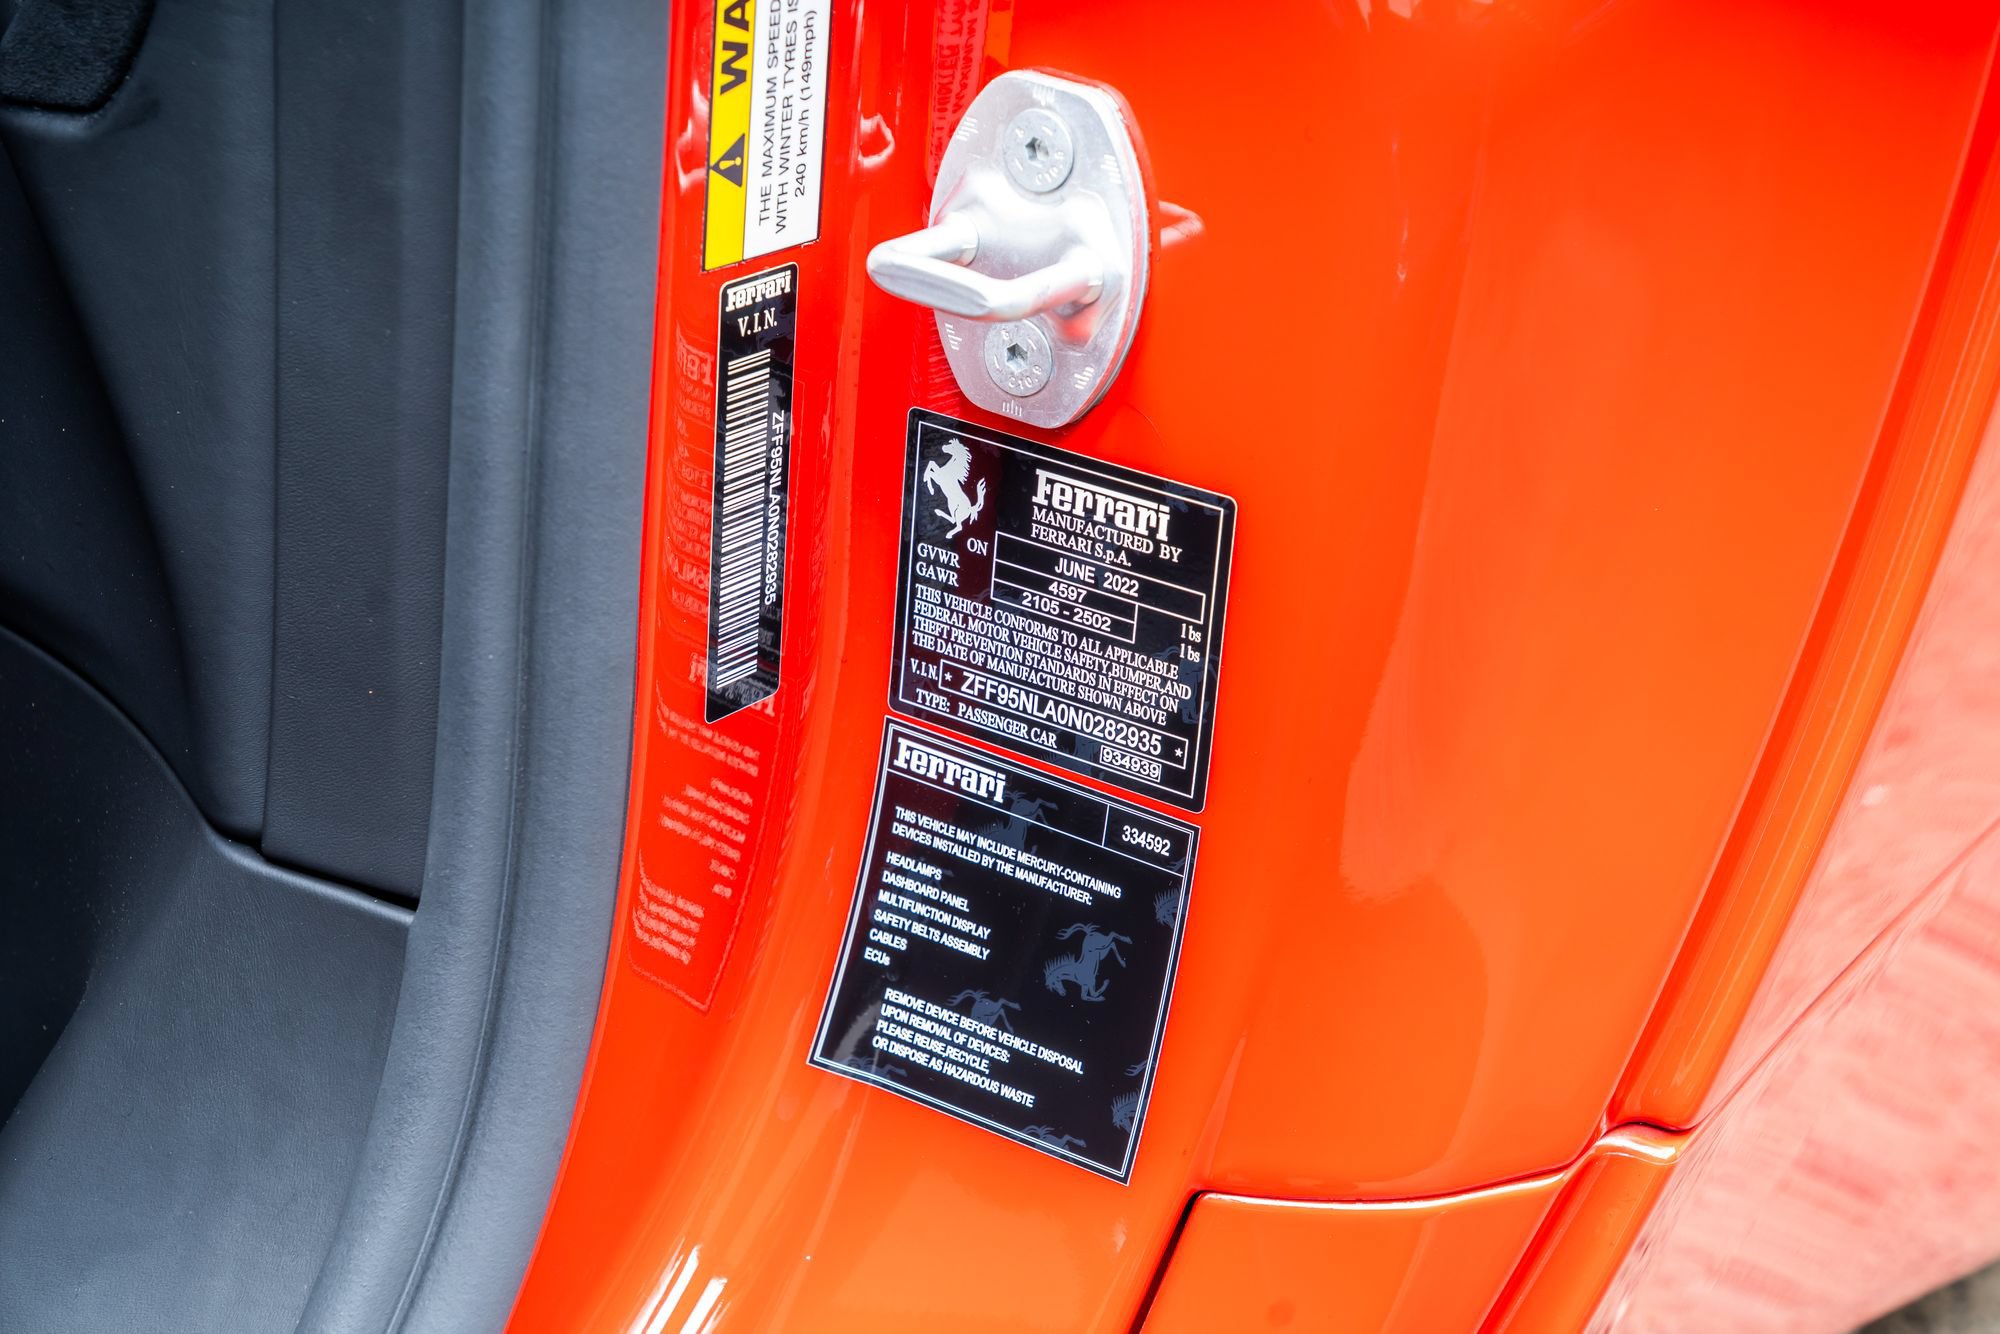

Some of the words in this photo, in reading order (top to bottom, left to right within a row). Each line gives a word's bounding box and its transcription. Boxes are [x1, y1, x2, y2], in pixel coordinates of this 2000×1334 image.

[767, 0, 781, 69] SPEED
[783, 20, 798, 91] TYRES
[800, 10, 818, 102] (149mph)
[762, 75, 778, 179] MAXIMUM
[778, 94, 793, 177] WINTER
[797, 108, 810, 162] km/h
[759, 183, 772, 226] THE
[794, 163, 807, 197] 240
[775, 181, 788, 234] WITH
[725, 270, 792, 312] Ferrari
[737, 307, 778, 337] V.I.N.
[764, 409, 785, 606] ZFF95NLA0N0282935
[1031, 468, 1171, 542] Ferrari
[917, 542, 961, 569] GVWR
[966, 537, 989, 556] ON
[1030, 522, 1093, 555] FERRARI
[1094, 542, 1132, 567] S.p.A.
[1032, 505, 1154, 554] MANUFACTURED
[1158, 543, 1183, 563] BY
[915, 561, 959, 588] GAWR
[1048, 581, 1088, 603] 4597
[1054, 557, 1096, 584] JUNE
[1102, 571, 1140, 598] 2022
[913, 598, 967, 632] FEDERAL
[967, 616, 1010, 644] MOTOR
[1011, 630, 1063, 660] VEHICLE
[915, 583, 942, 605] THIS
[943, 591, 993, 621] VEHICLE
[993, 609, 1059, 642] CONFORMS
[1060, 629, 1078, 648] TO
[1078, 636, 1103, 657] ALL
[1103, 644, 1179, 680] APPLICABLE
[1021, 591, 1060, 615] 2105
[1072, 607, 1112, 632] 2502
[910, 657, 939, 681] V.I.N.
[911, 629, 936, 651] THE
[935, 637, 969, 662] DATE
[969, 649, 986, 667] OF
[986, 654, 1077, 697] MANUFACTURE
[1077, 684, 1123, 712] SHOWN
[1122, 700, 1167, 726] ABOVE
[913, 614, 950, 639] THEFT
[950, 626, 1025, 664] PREVENTION
[1024, 651, 1097, 687] STANDARDS
[1097, 674, 1113, 692] IN
[1112, 679, 1159, 707] EFFECT
[1159, 694, 1180, 714] ON
[915, 687, 951, 713] TYPE:
[957, 701, 1029, 740] PASSENGER
[1030, 727, 1058, 749] CAR
[960, 670, 1162, 756] ZFF95NLA0N0282935
[893, 736, 1006, 804] Ferrari
[1102, 748, 1161, 780] 934939
[885, 850, 943, 881] HEADLAMPS
[891, 821, 933, 846] DEVICES
[932, 835, 981, 864] INSTALLED
[980, 854, 996, 869] BY
[995, 859, 1015, 877] THE
[1014, 866, 1093, 906] MANUFACTURER:
[895, 805, 917, 824] THIS
[917, 813, 957, 839] VEHICLE
[955, 827, 978, 846] MAY
[976, 835, 1017, 861] INCLUDE
[1016, 850, 1122, 899] MERCURY-CONTAINING
[1121, 824, 1171, 857] 334592
[877, 888, 952, 926] MULTIFUNCTION
[951, 915, 992, 940] DISPLAY
[881, 869, 940, 900] DASHBOARD
[939, 890, 970, 913] PANEL
[863, 946, 891, 966] ECUs
[869, 927, 908, 951] CABLES
[873, 908, 912, 931] SAFETY
[910, 921, 941, 942] BELTS
[939, 932, 991, 961] ASSEMBLY
[875, 1018, 915, 1043] PLEASE
[880, 1003, 910, 1024] UPON
[908, 1013, 953, 1041] REMOVAL
[953, 1031, 969, 1046] OF
[966, 1036, 1011, 1063] DEVICES:
[884, 987, 926, 1013] REMOVE
[924, 1002, 961, 1026] DEVICE
[958, 1015, 998, 1041] BEFORE
[998, 1030, 1038, 1057] VEHICLE
[1036, 1045, 1084, 1075] DISPOSAL
[872, 1035, 890, 1051] OR
[888, 1040, 931, 1067] DISPOSE
[927, 1056, 944, 1072] AS
[942, 1061, 1001, 1094] HAZARDOUS
[1000, 1083, 1035, 1108] WASTE
